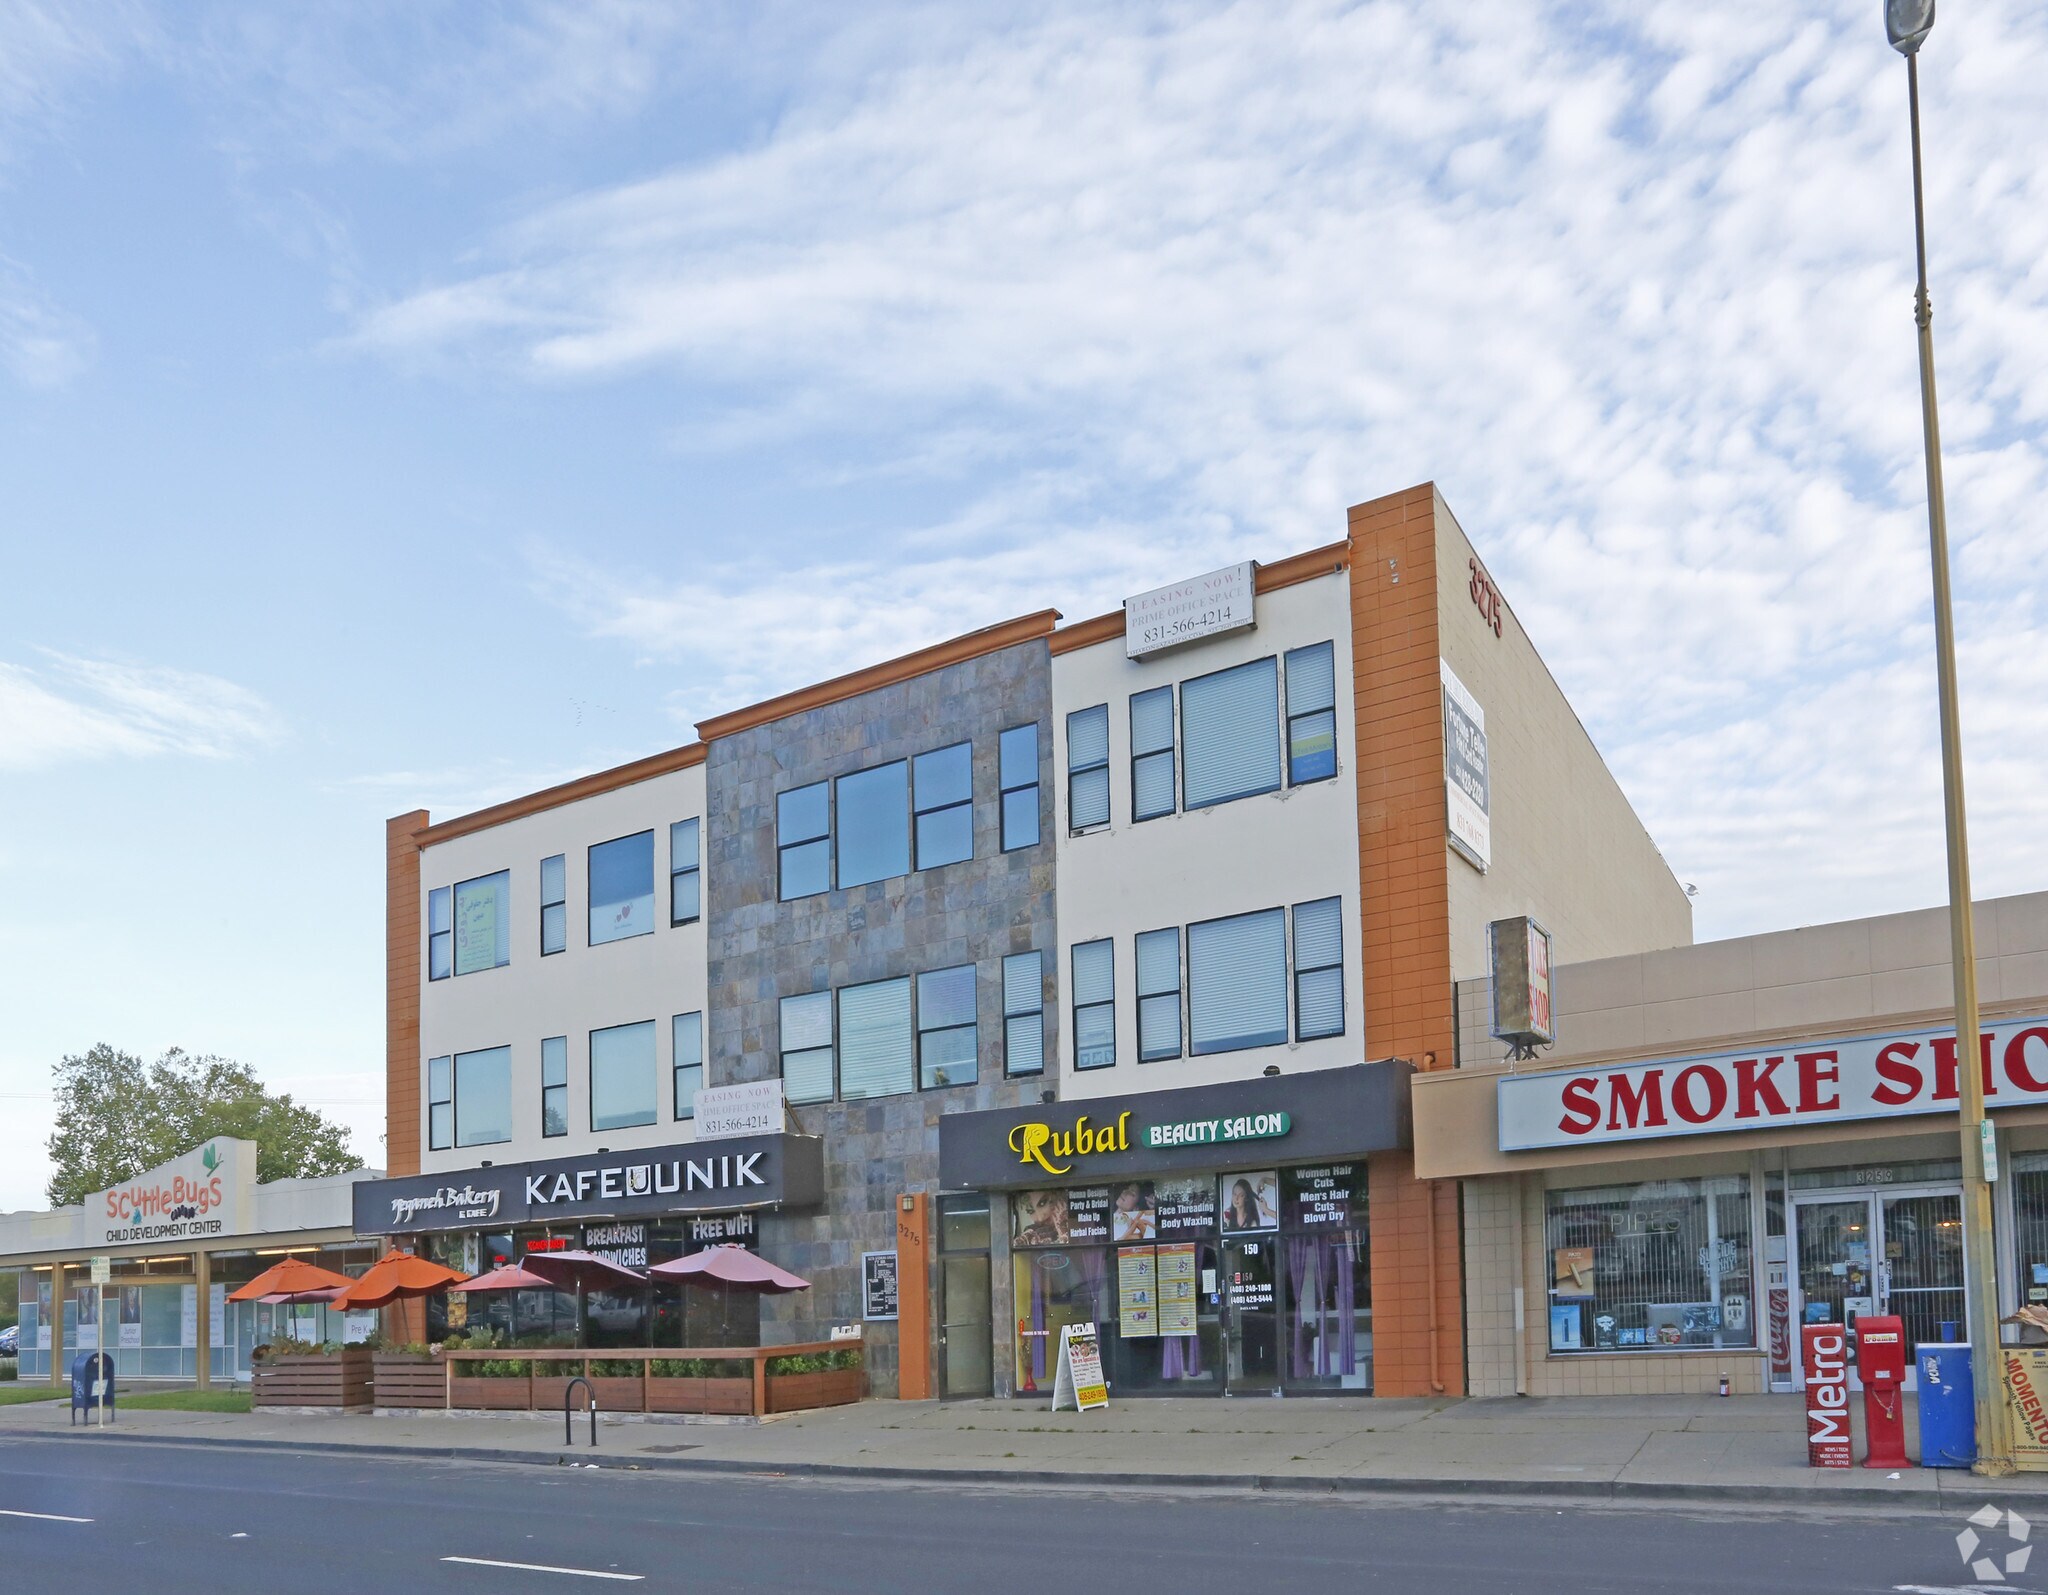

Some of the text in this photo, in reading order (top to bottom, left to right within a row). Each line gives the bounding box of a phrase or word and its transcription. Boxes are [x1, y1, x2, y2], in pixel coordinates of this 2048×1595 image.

[1131, 586, 1194, 613] LEASING
[1131, 586, 1245, 628] PRIME OFFICE SPACE
[1468, 557, 1503, 639] 3275
[1143, 605, 1232, 644] 831-566-4214
[703, 1086, 771, 1103] EASING NOW
[1557, 1049, 1840, 1135] SMOKE
[723, 1102, 750, 1114] OFFICE
[751, 1100, 773, 1111] SPAC
[705, 1115, 768, 1133] 831-566-4214
[1150, 1112, 1283, 1145] BEAUTY SALON
[1008, 1111, 1131, 1175] Rubal
[525, 1152, 766, 1205] KAFE UNIK
[1296, 1165, 1353, 1180] Women Hair
[1857, 1169, 1893, 1184] 3259
[1313, 1178, 1335, 1189] Cuts
[1070, 1199, 1109, 1210] Party & Bridal
[1300, 1188, 1350, 1203] Men's Hair
[1158, 1202, 1214, 1216] Face Threading
[1314, 1201, 1335, 1212] Cuts
[1077, 1212, 1100, 1222] Make Up
[1161, 1216, 1213, 1229] Body Waxing
[1303, 1210, 1345, 1224] Blow Dry
[1610, 1209, 1681, 1233] PIPES
[106, 1220, 222, 1242] CHILD DEVELOPMENT CENTER
[692, 1214, 753, 1240] FREE WIFI
[898, 1223, 920, 1247] 3275
[1088, 1226, 1107, 1237] Facials
[586, 1226, 645, 1247] BREAKFAST
[1243, 1243, 1259, 1255] 150
[351, 1325, 362, 1335] Pre
[1805, 1335, 1850, 1443] Metro
[2001, 1375, 2036, 1441] Spanish Yellow Pages
